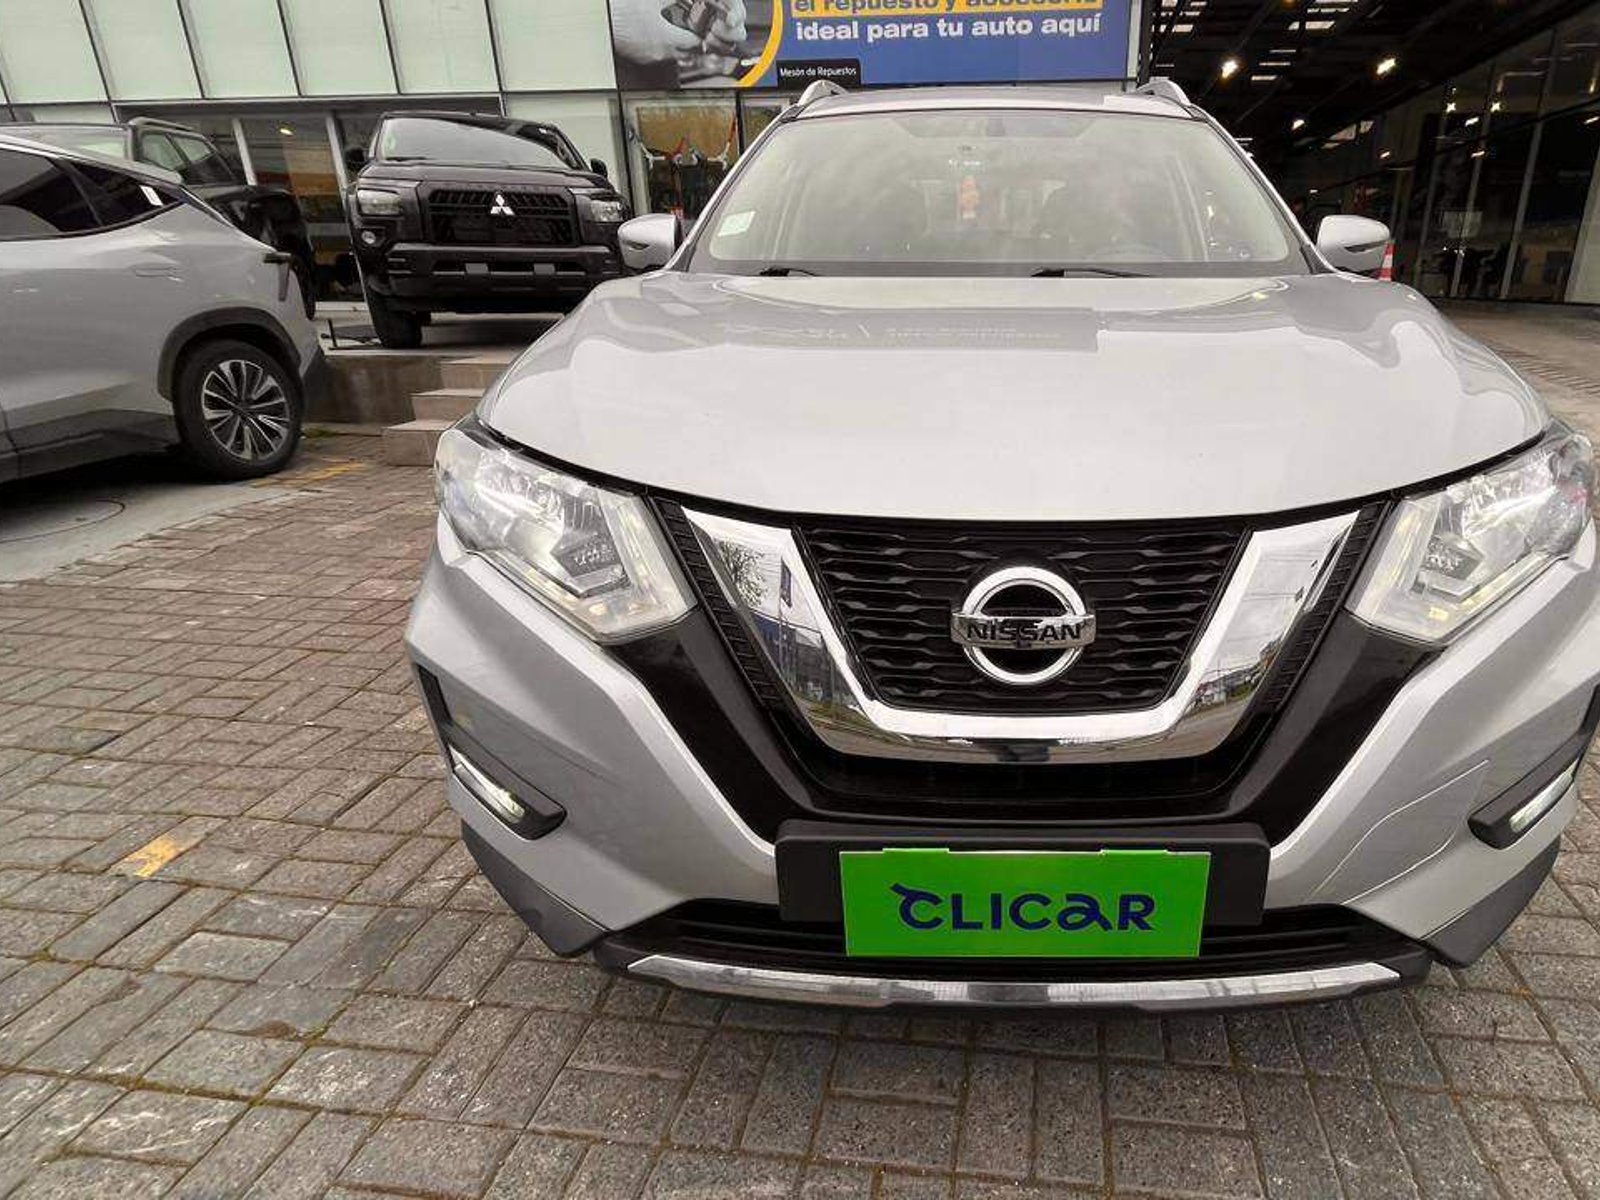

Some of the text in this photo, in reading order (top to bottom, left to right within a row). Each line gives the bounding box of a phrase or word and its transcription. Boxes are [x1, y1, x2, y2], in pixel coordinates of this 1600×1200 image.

[796, 13, 1101, 43] ideal para tu auto aquí
[780, 66, 857, 78] Mesón de Repuestos
[967, 622, 1082, 641] NISSAN
